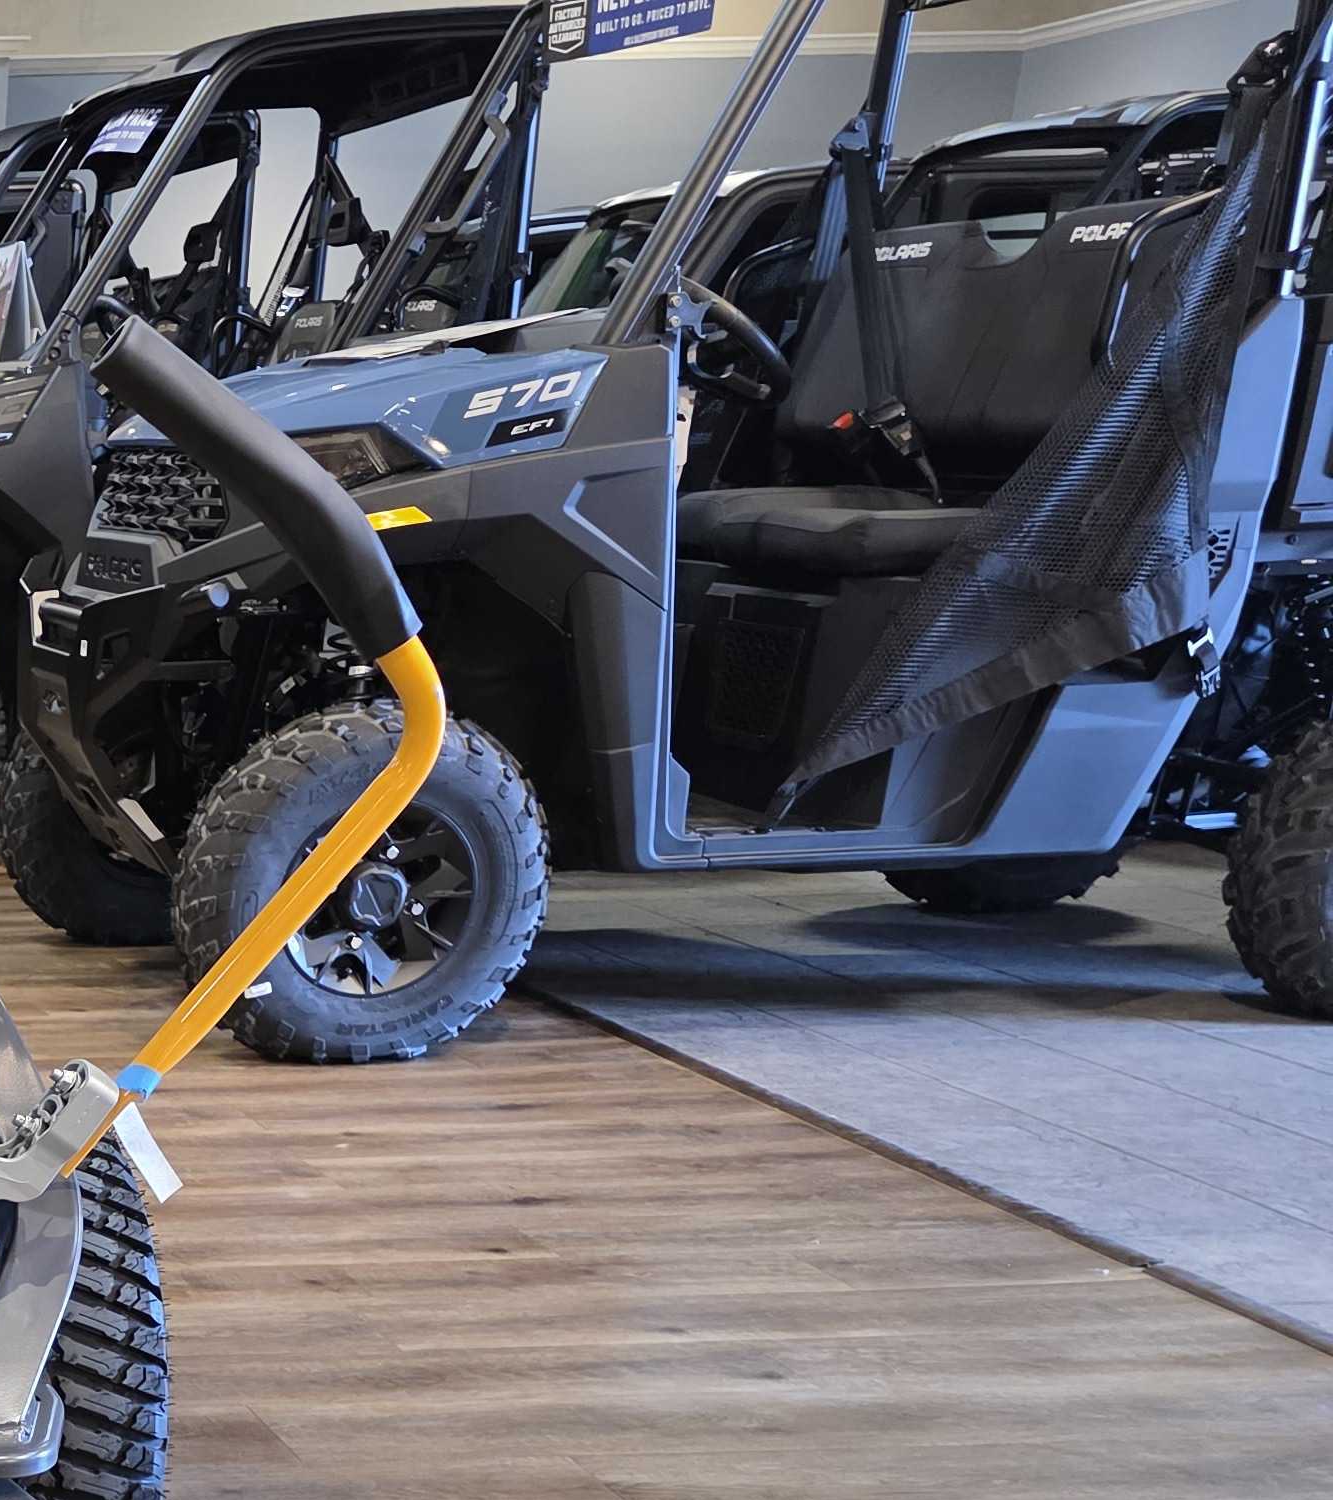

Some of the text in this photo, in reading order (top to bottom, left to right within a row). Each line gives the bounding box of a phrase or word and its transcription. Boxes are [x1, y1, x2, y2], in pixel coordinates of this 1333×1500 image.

[554, 6, 582, 21] FACTORY
[595, 17, 618, 35] BUILT
[620, 16, 629, 29] TO
[646, 6, 674, 23] PRICED
[676, 3, 686, 14] TO
[1070, 221, 1132, 243] POLAR
[294, 316, 324, 328] POLARIS
[463, 371, 582, 419] 570
[510, 417, 555, 436] EFI
